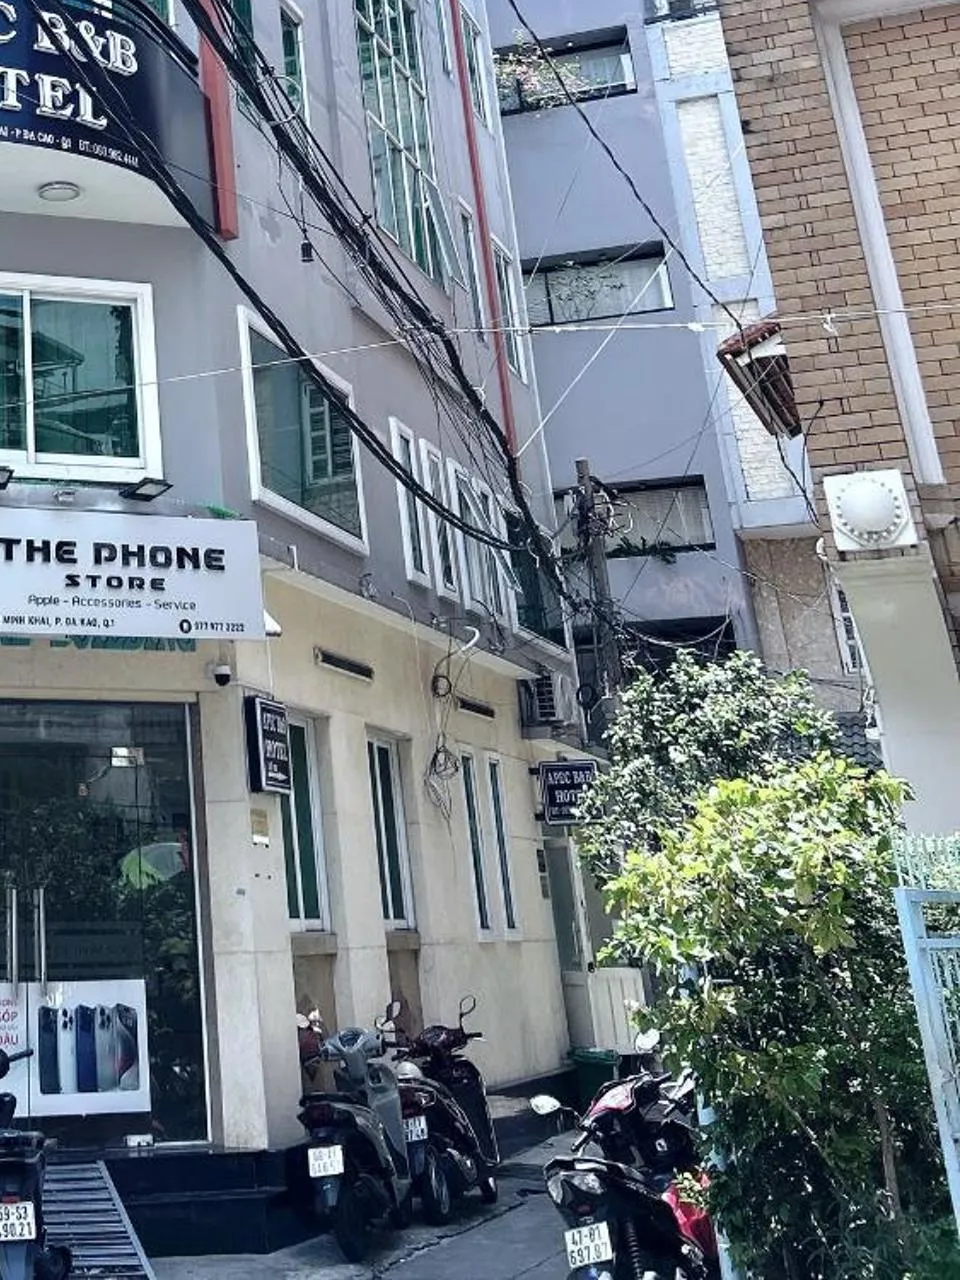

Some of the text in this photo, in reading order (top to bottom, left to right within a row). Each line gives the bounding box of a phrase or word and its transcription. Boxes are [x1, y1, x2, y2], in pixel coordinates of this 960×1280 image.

[33, 10, 138, 76] B&B
[92, 542, 226, 570] PHONE
[65, 574, 166, 591] STORE
[27, 594, 60, 607] Apple
[72, 596, 141, 608] Accessories
[154, 598, 196, 611] Service
[3, 615, 26, 625] MINH
